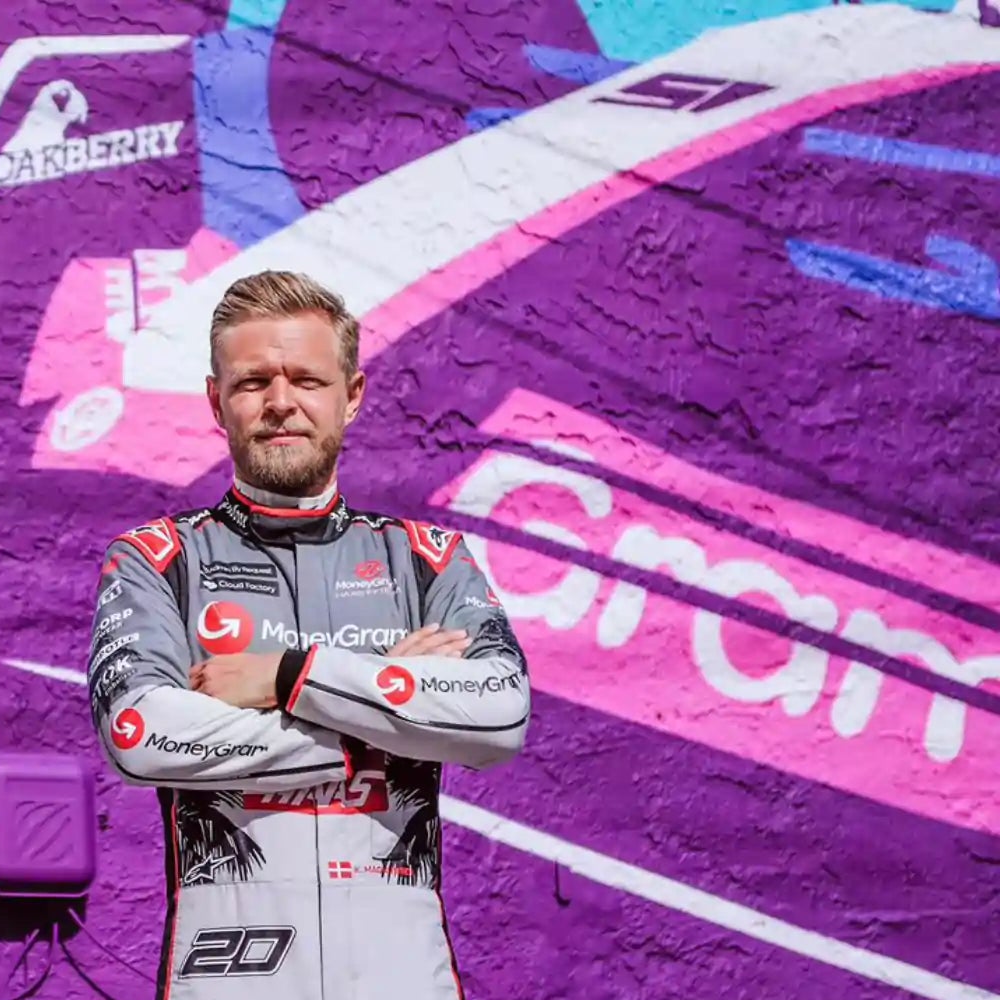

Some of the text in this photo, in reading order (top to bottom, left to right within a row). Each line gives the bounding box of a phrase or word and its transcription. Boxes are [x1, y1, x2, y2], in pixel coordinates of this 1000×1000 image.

[218, 580, 276, 594] Cloud Factory
[178, 925, 297, 980] 20
